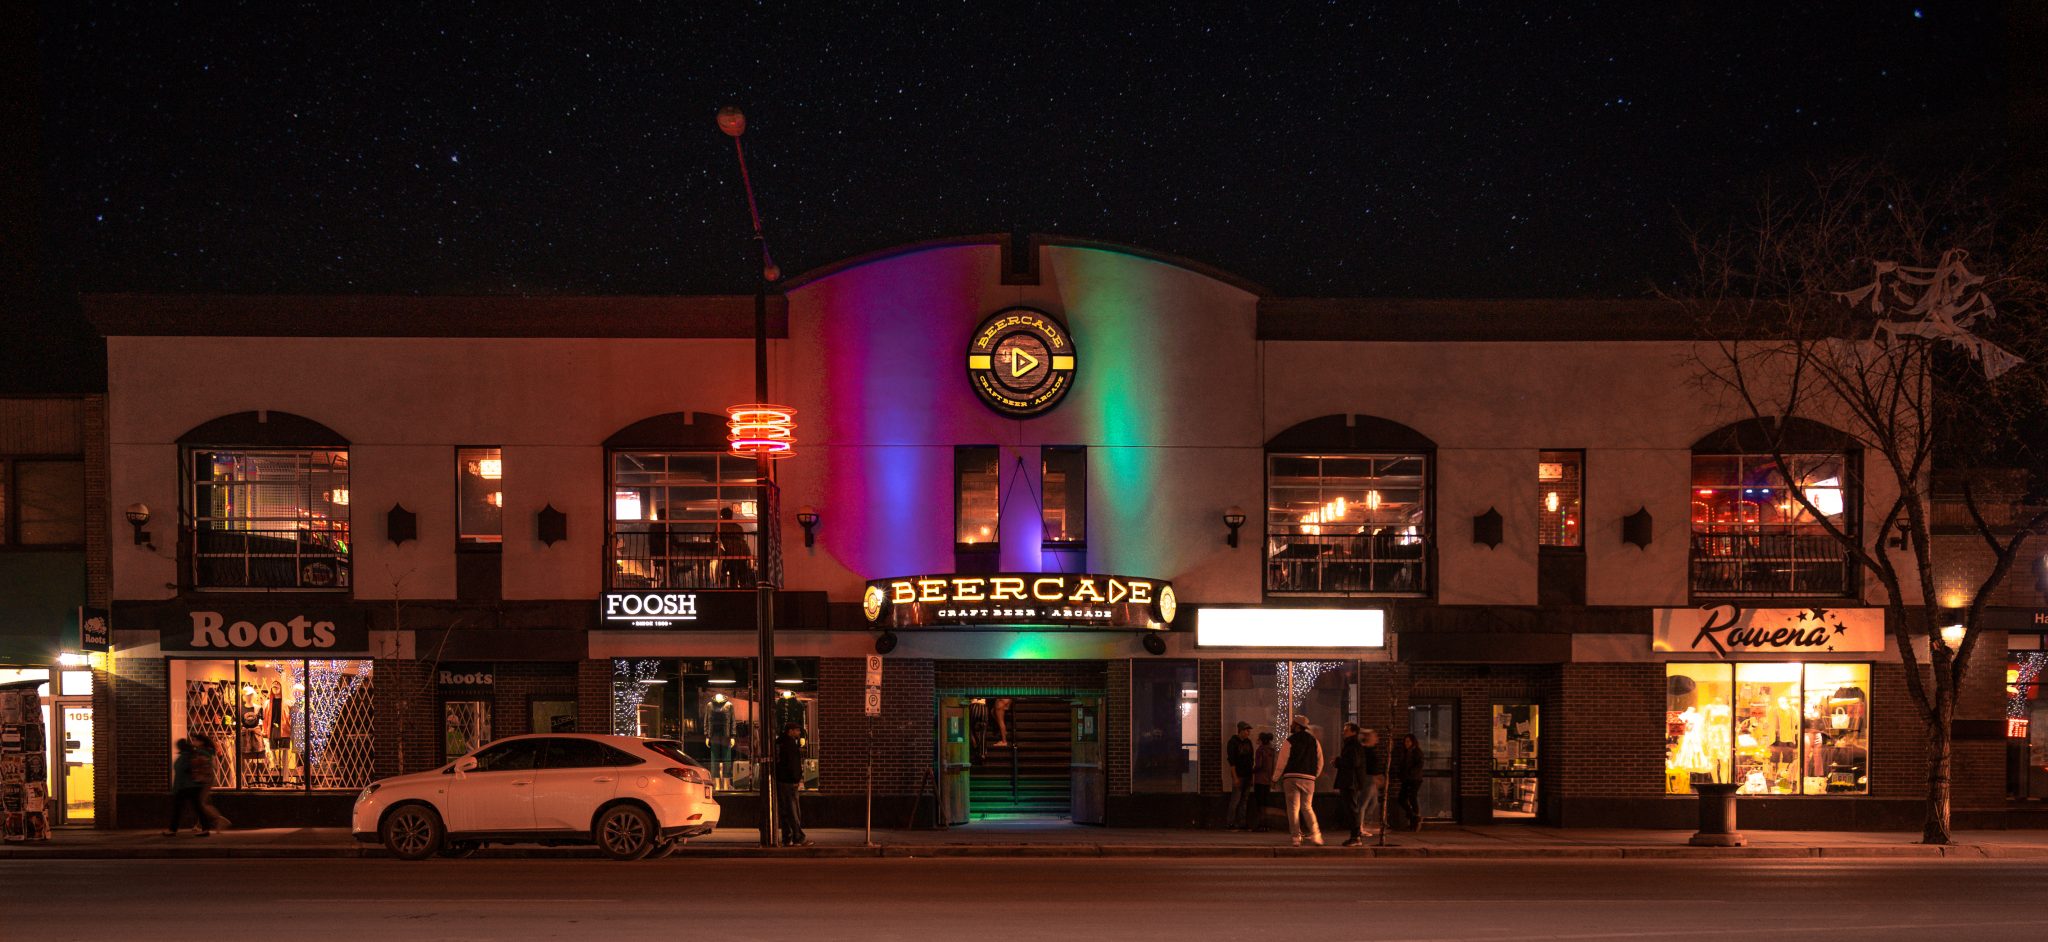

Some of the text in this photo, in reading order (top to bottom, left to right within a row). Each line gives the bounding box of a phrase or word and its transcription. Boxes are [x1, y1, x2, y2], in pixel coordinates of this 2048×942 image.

[978, 316, 1064, 348] BEERCADE
[980, 375, 1064, 408] CRAFT BEER ARCADE
[606, 594, 697, 615] FOOSH
[938, 609, 1112, 618] CRAFT BEER ARCADE
[85, 634, 106, 645] Roots
[189, 611, 336, 648] Roots
[1692, 602, 1830, 658] Rowena
[439, 670, 493, 685] Roots
